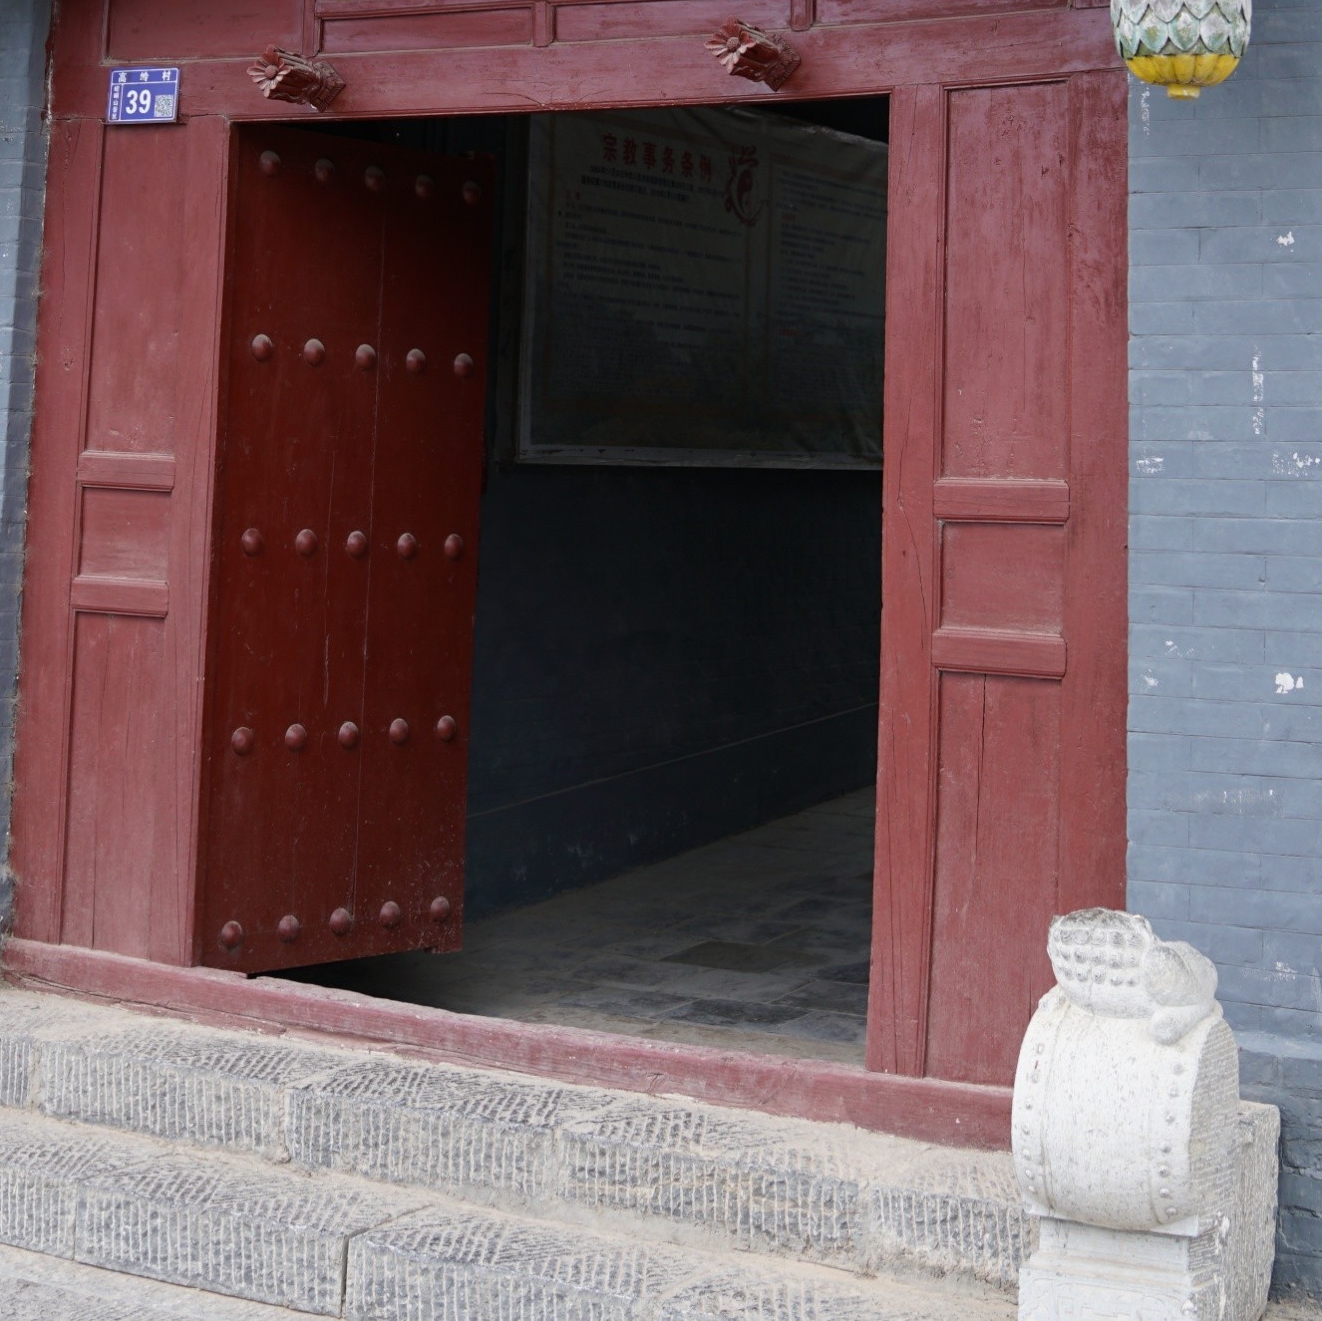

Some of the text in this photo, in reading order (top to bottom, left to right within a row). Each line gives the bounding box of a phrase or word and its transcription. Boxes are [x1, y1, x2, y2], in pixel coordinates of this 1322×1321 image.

[125, 89, 151, 114] 39
[602, 133, 712, 182] 宗教事务条例
